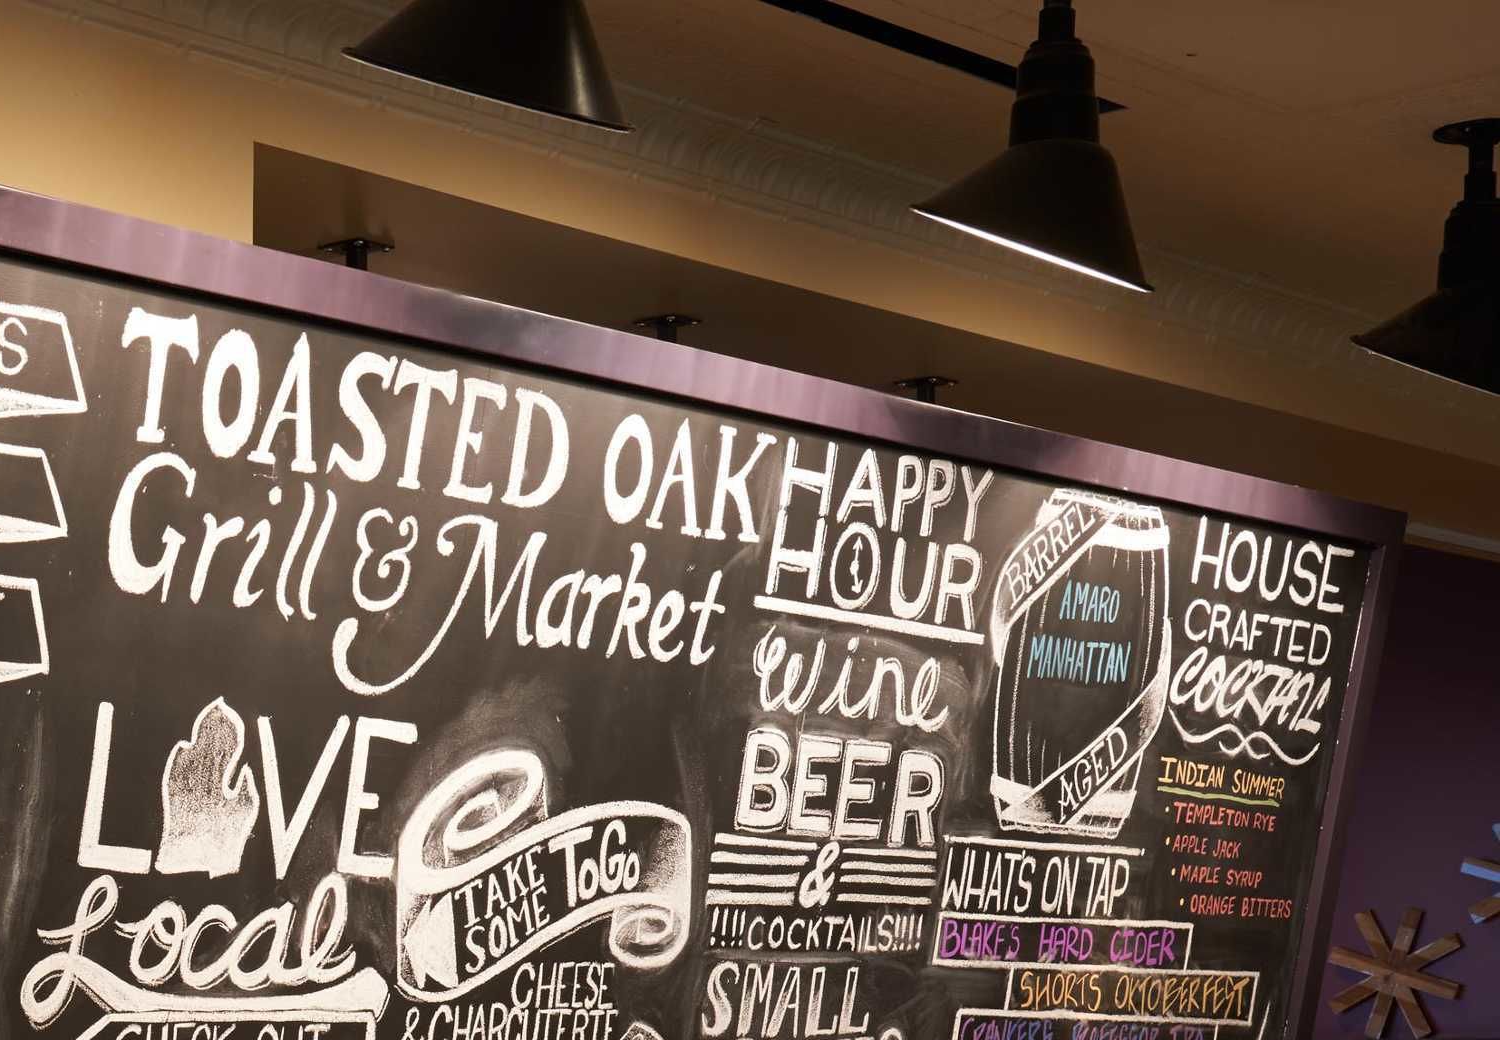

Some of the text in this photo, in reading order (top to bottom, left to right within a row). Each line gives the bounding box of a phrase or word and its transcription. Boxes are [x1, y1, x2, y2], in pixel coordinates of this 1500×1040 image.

[121, 306, 777, 544] TOASTED OAK
[779, 436, 995, 542] HAPPY
[108, 450, 726, 697] Grill & Market
[765, 509, 983, 630] HOUR
[1005, 502, 1098, 612] BARREL
[1190, 514, 1356, 615] HOUSE
[1059, 578, 1122, 625] AMARO
[1184, 598, 1333, 667] CRAFTED
[1026, 635, 1133, 686] MANHATTAN
[77, 700, 419, 879] LVE
[733, 727, 946, 848] BEER
[1058, 724, 1129, 825] AGED
[1156, 756, 1286, 799] INDIAN SUMMER
[1172, 800, 1278, 832] TEMPLETON RYE
[1172, 835, 1242, 858] APPLE JACK
[454, 846, 548, 930] TAKE
[798, 840, 840, 909] &
[940, 847, 1131, 917] WHAT'S ON TAP
[1179, 866, 1263, 889] MAPLE SYRUP
[1190, 895, 1292, 920] ORANGE BITTERS
[20, 873, 389, 1030] Local
[464, 886, 552, 973] SOME
[938, 919, 1177, 967] BLAKE'S HARD CIDER
[509, 961, 617, 1013] CHEESE
[701, 960, 870, 1038] SMALL
[1019, 969, 1102, 1012] SHORTS
